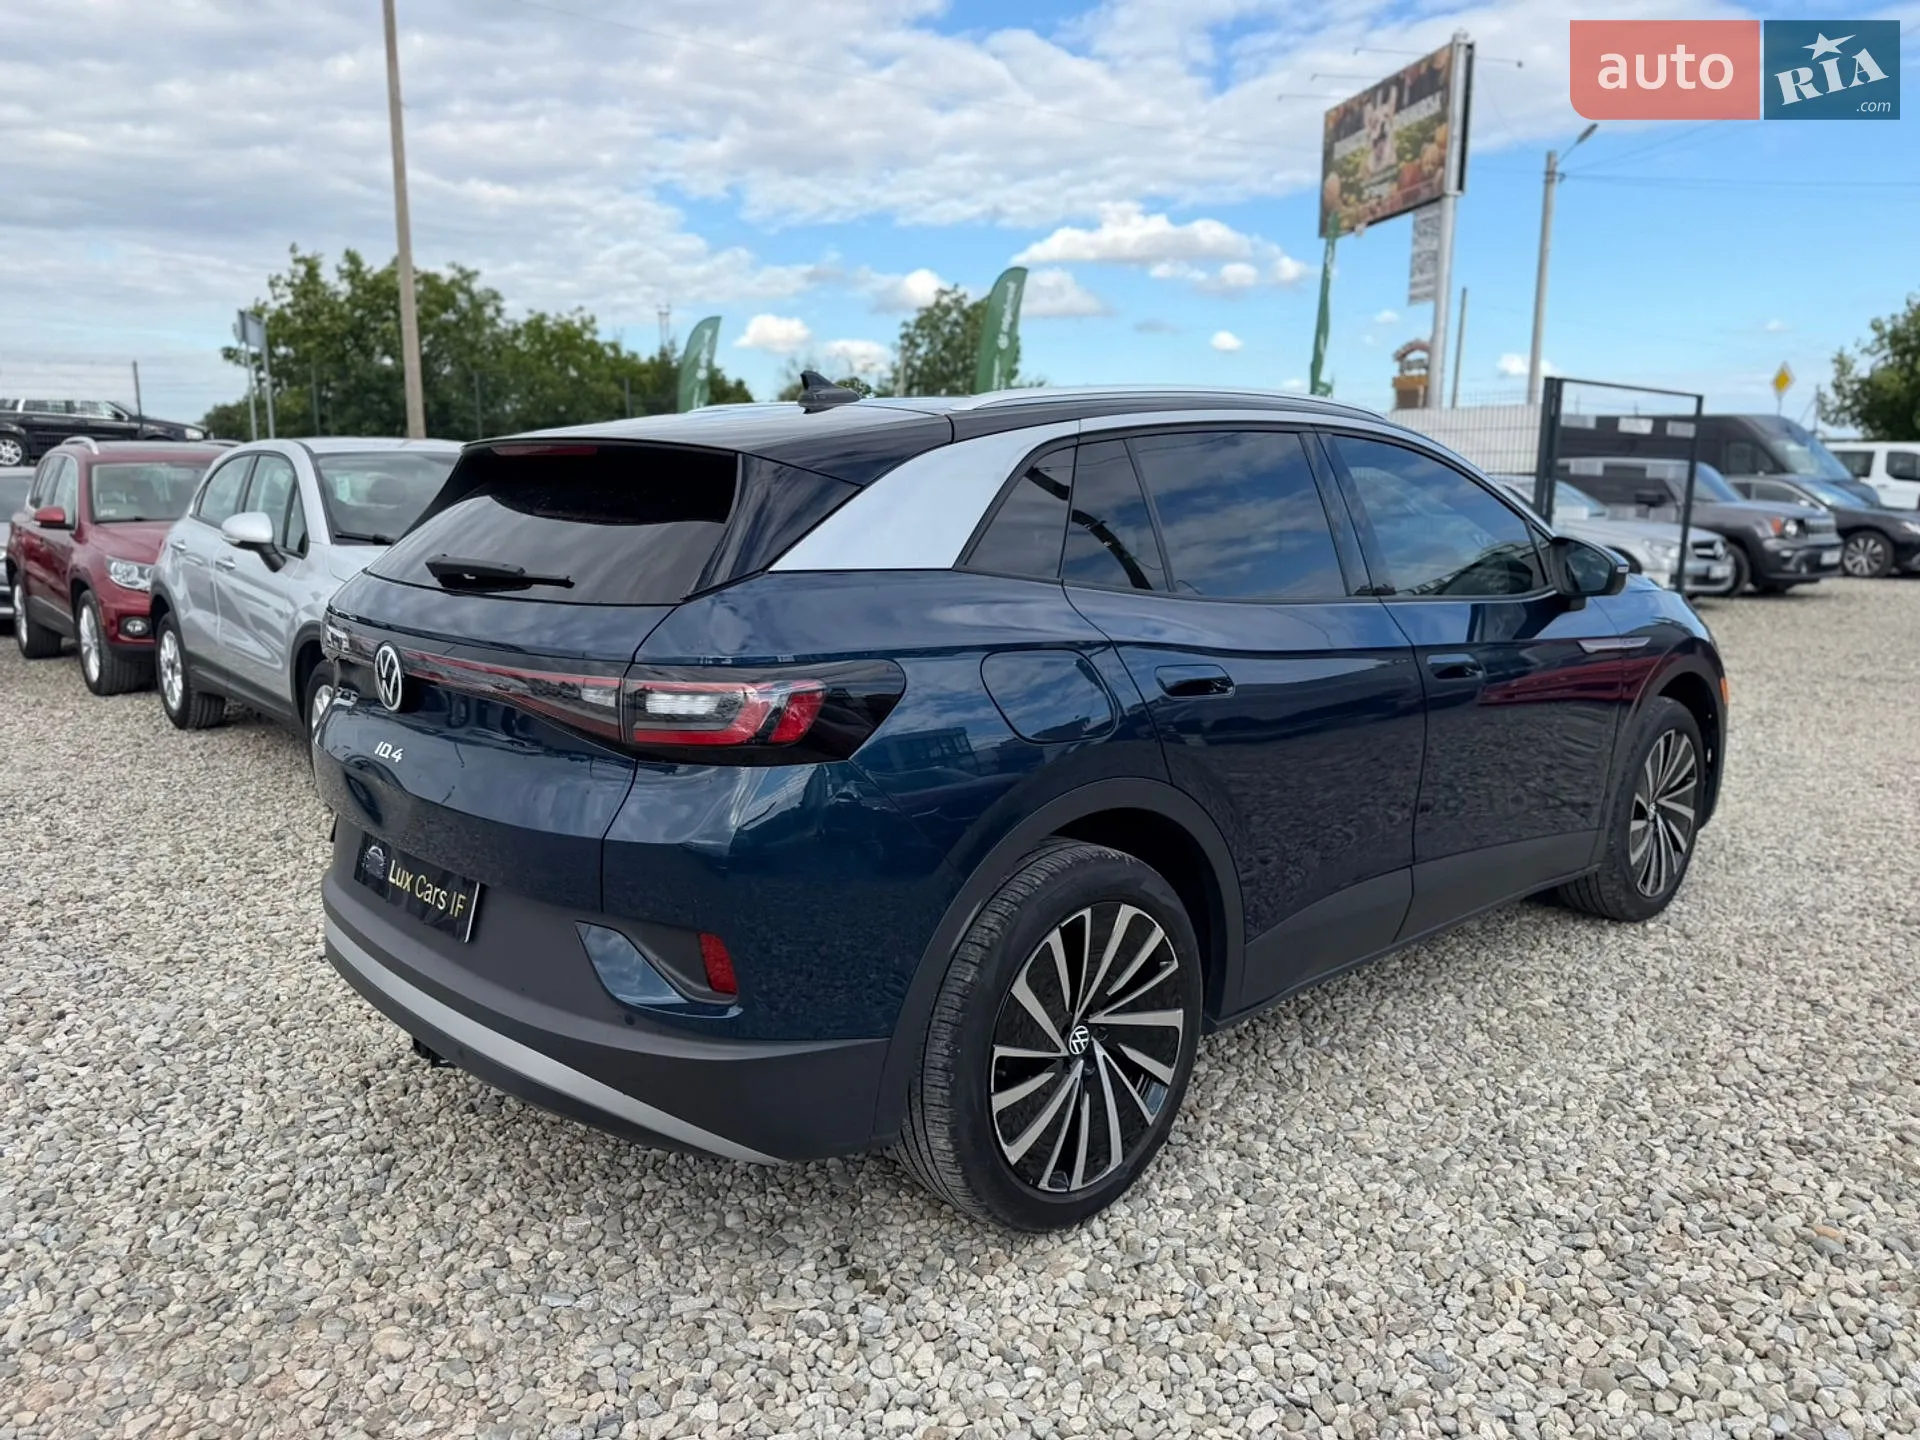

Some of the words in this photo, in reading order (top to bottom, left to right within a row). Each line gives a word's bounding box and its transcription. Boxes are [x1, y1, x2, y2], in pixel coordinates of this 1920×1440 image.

[388, 860, 414, 893] Lux
[415, 875, 448, 910] Cars
[449, 891, 467, 918] IF
